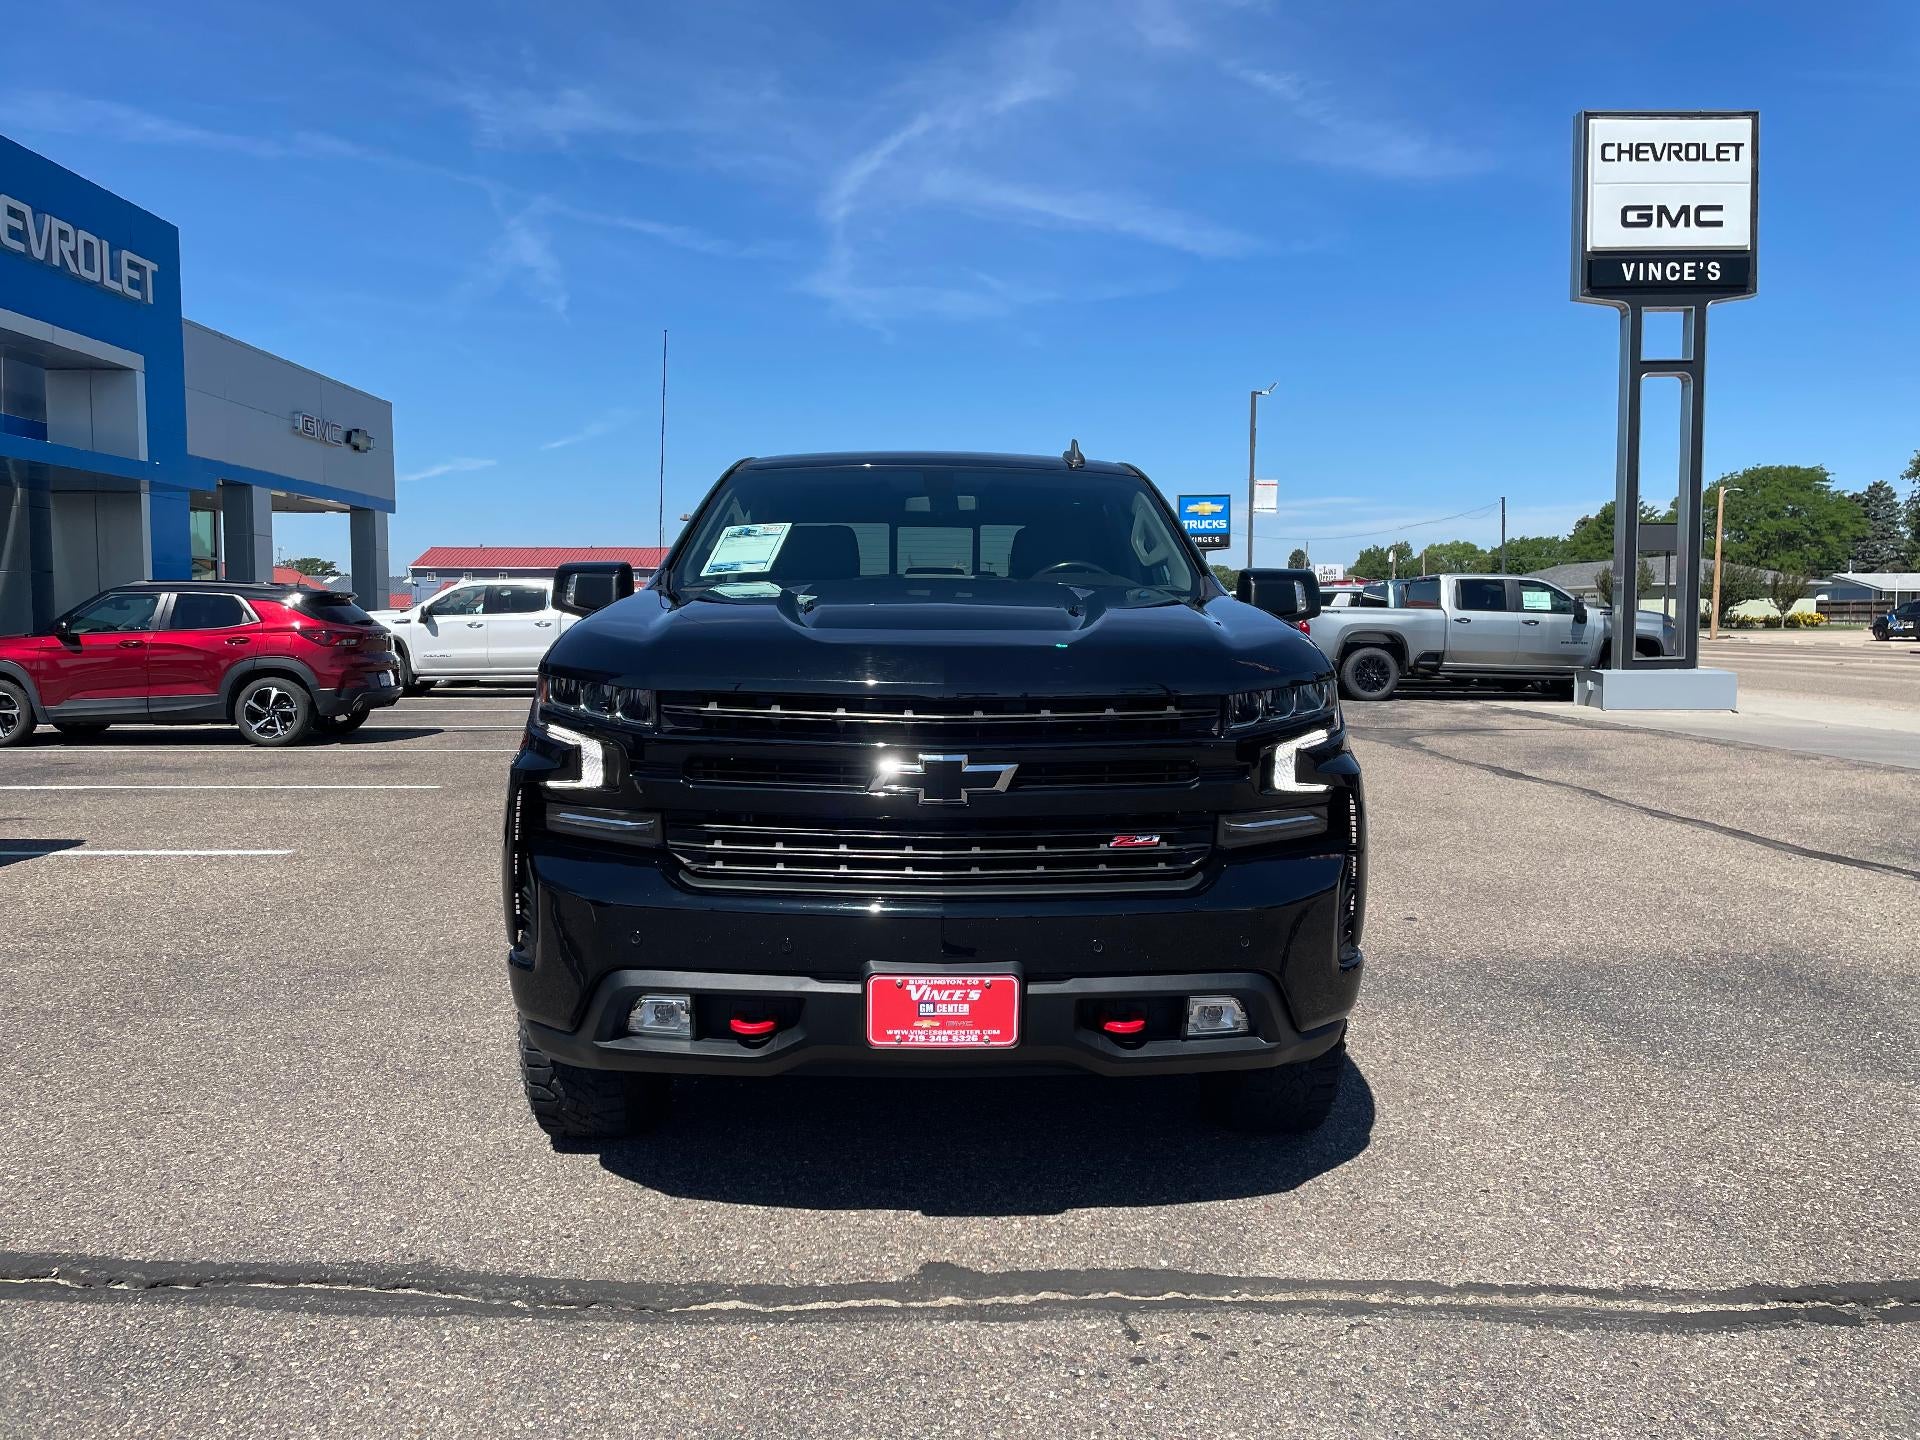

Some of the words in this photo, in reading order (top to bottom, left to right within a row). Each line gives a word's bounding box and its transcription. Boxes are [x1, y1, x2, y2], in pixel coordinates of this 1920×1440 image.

[1600, 142, 1744, 162] CHEVROLET
[1620, 204, 1724, 228] GMC
[1621, 261, 1721, 281] VINCE'S
[297, 412, 344, 447] GMC
[1183, 519, 1227, 529] TRUCKS
[905, 985, 982, 1001] VINCE'S
[919, 1003, 934, 1013] GM
[936, 1003, 969, 1013] CENTER
